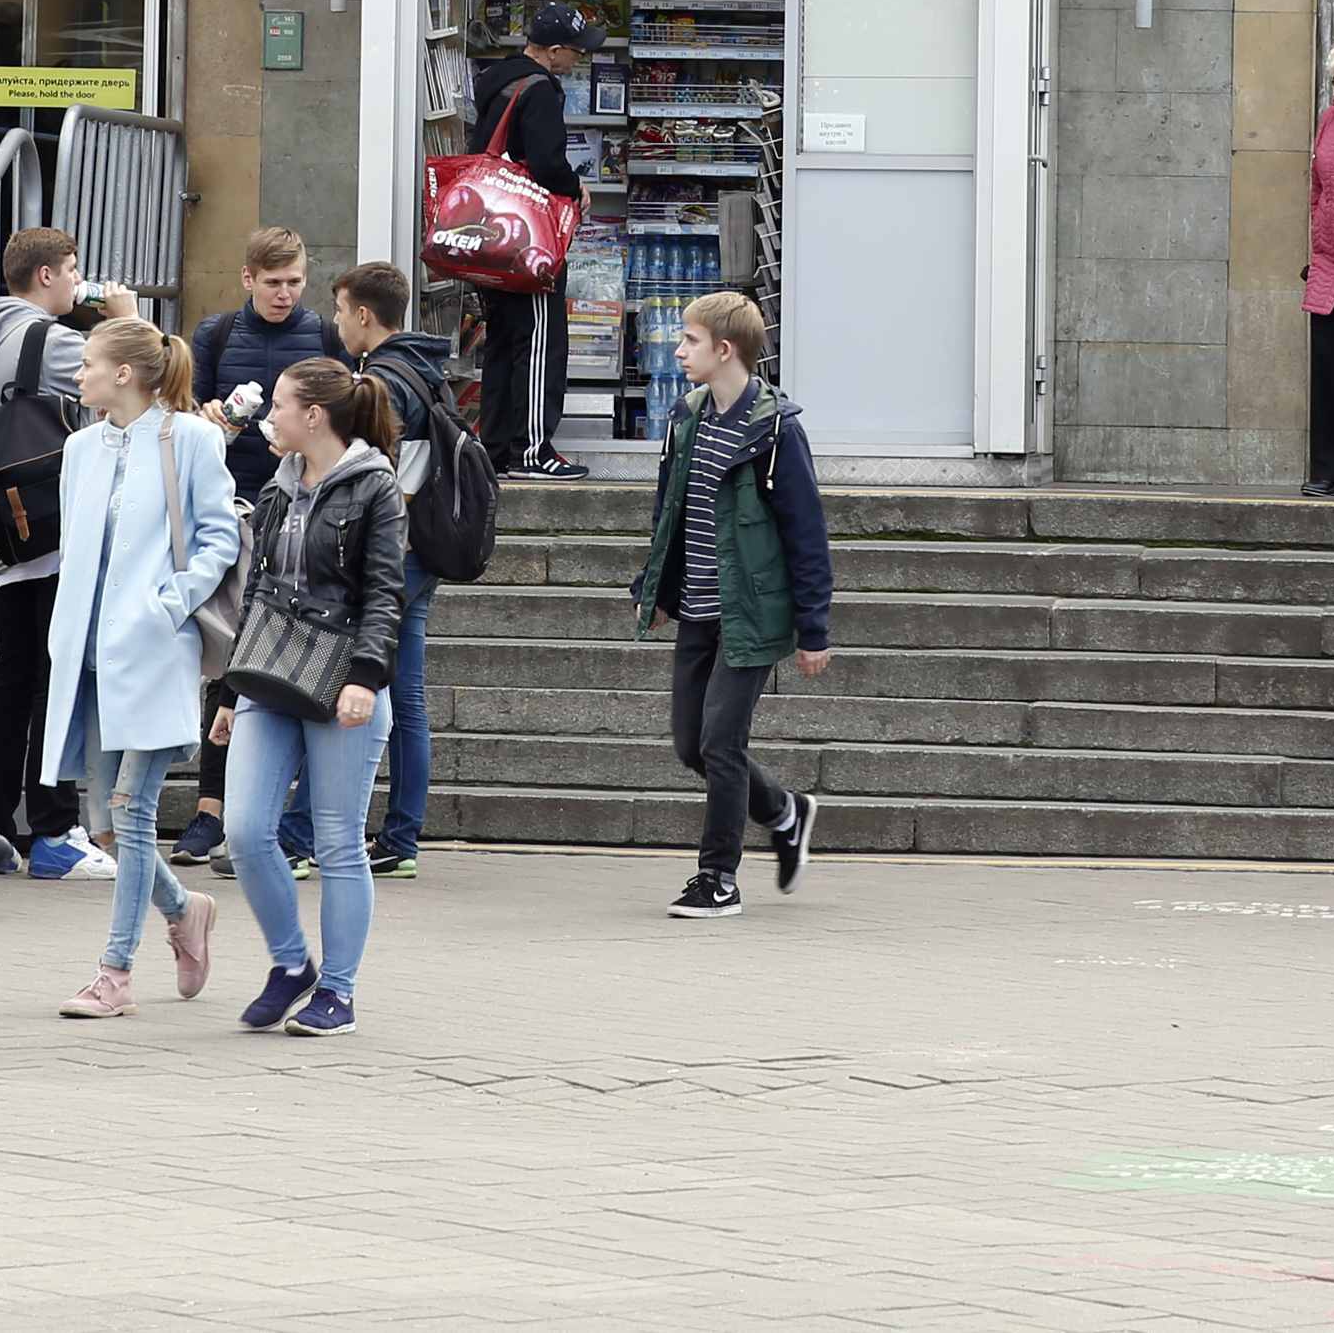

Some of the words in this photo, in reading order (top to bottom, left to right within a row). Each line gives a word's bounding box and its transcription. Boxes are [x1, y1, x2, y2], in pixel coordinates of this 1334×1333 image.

[38, 77, 99, 88] придержите
[100, 78, 130, 88] дверь
[8, 89, 38, 99] Please,
[39, 89, 59, 98] hold
[59, 90, 75, 98] the
[75, 91, 96, 99] door
